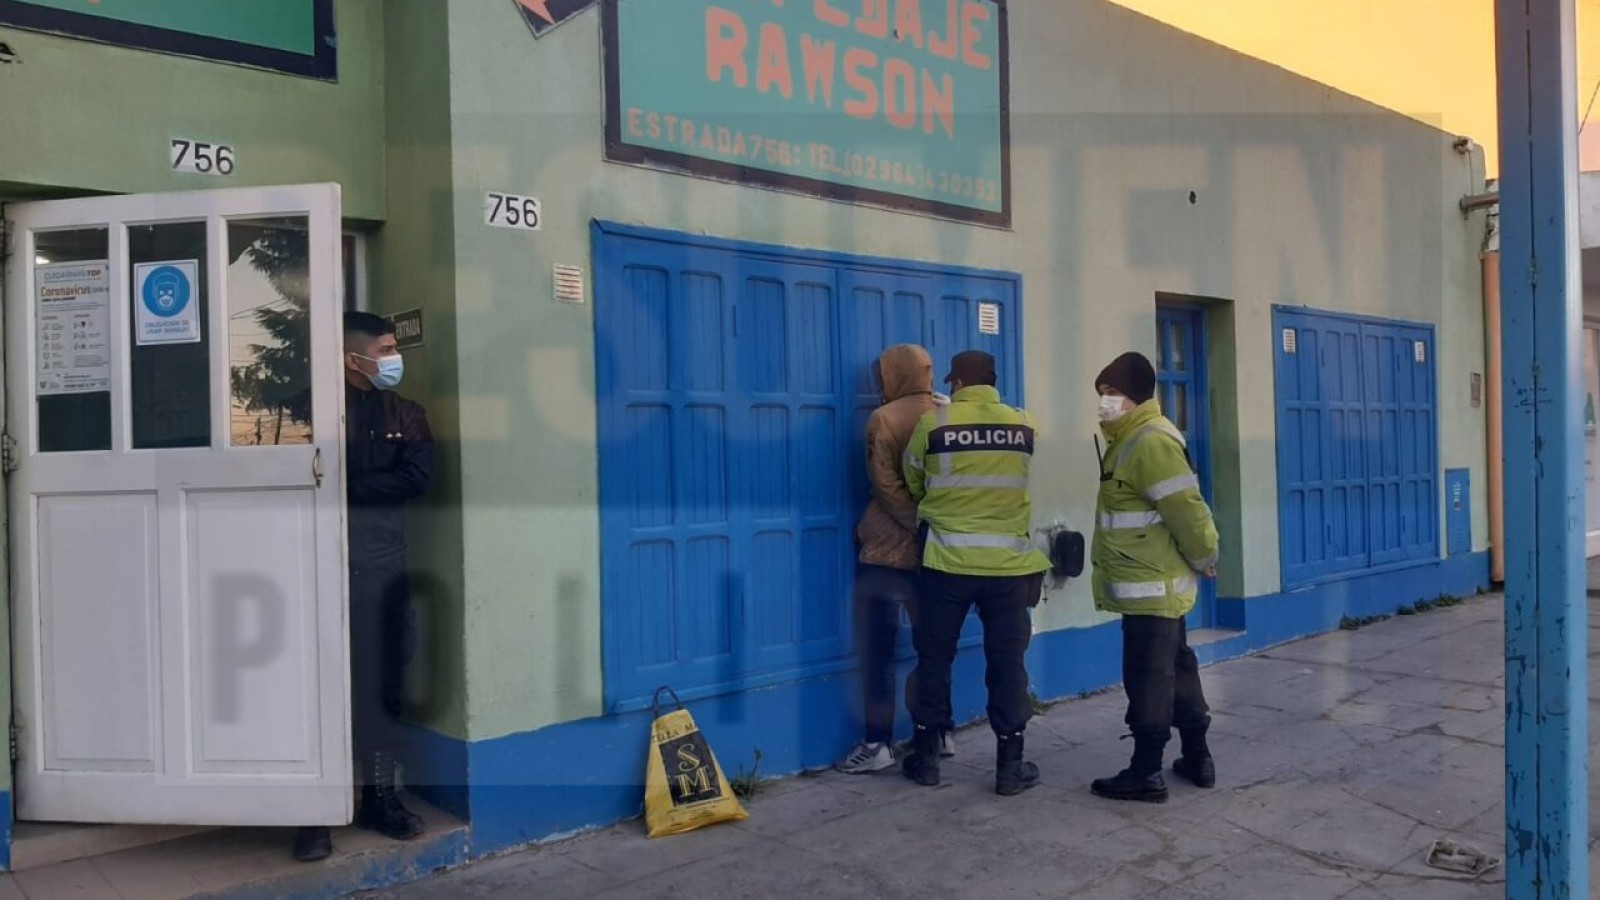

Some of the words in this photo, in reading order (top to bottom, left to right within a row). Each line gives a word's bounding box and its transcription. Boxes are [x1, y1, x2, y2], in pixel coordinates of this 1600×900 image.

[705, 6, 955, 140] RAWSON
[171, 139, 234, 175] 756
[488, 193, 538, 228] 756
[943, 429, 1026, 446] POLICIA
